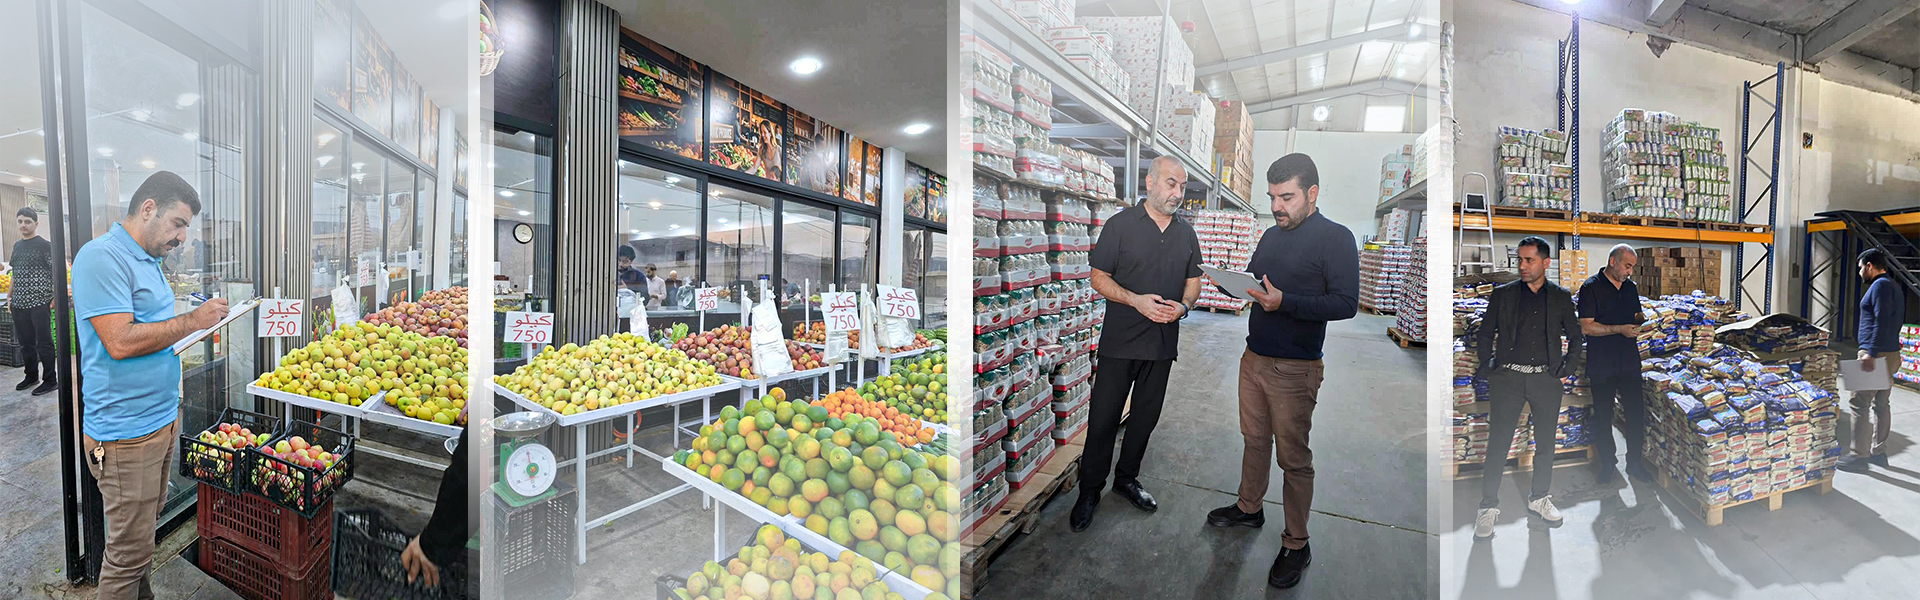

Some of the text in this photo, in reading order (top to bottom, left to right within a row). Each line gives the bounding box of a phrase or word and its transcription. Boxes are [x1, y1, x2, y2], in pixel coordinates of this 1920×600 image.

[696, 289, 717, 301] كيلو
[881, 288, 916, 303] كيلو
[261, 301, 301, 319] كيلو
[699, 300, 715, 310] 750
[825, 295, 856, 313] كيلو
[887, 303, 915, 318] 750
[265, 320, 296, 336] 750
[507, 313, 552, 328] كيلو
[830, 314, 856, 330] 750
[513, 329, 546, 343] 750
